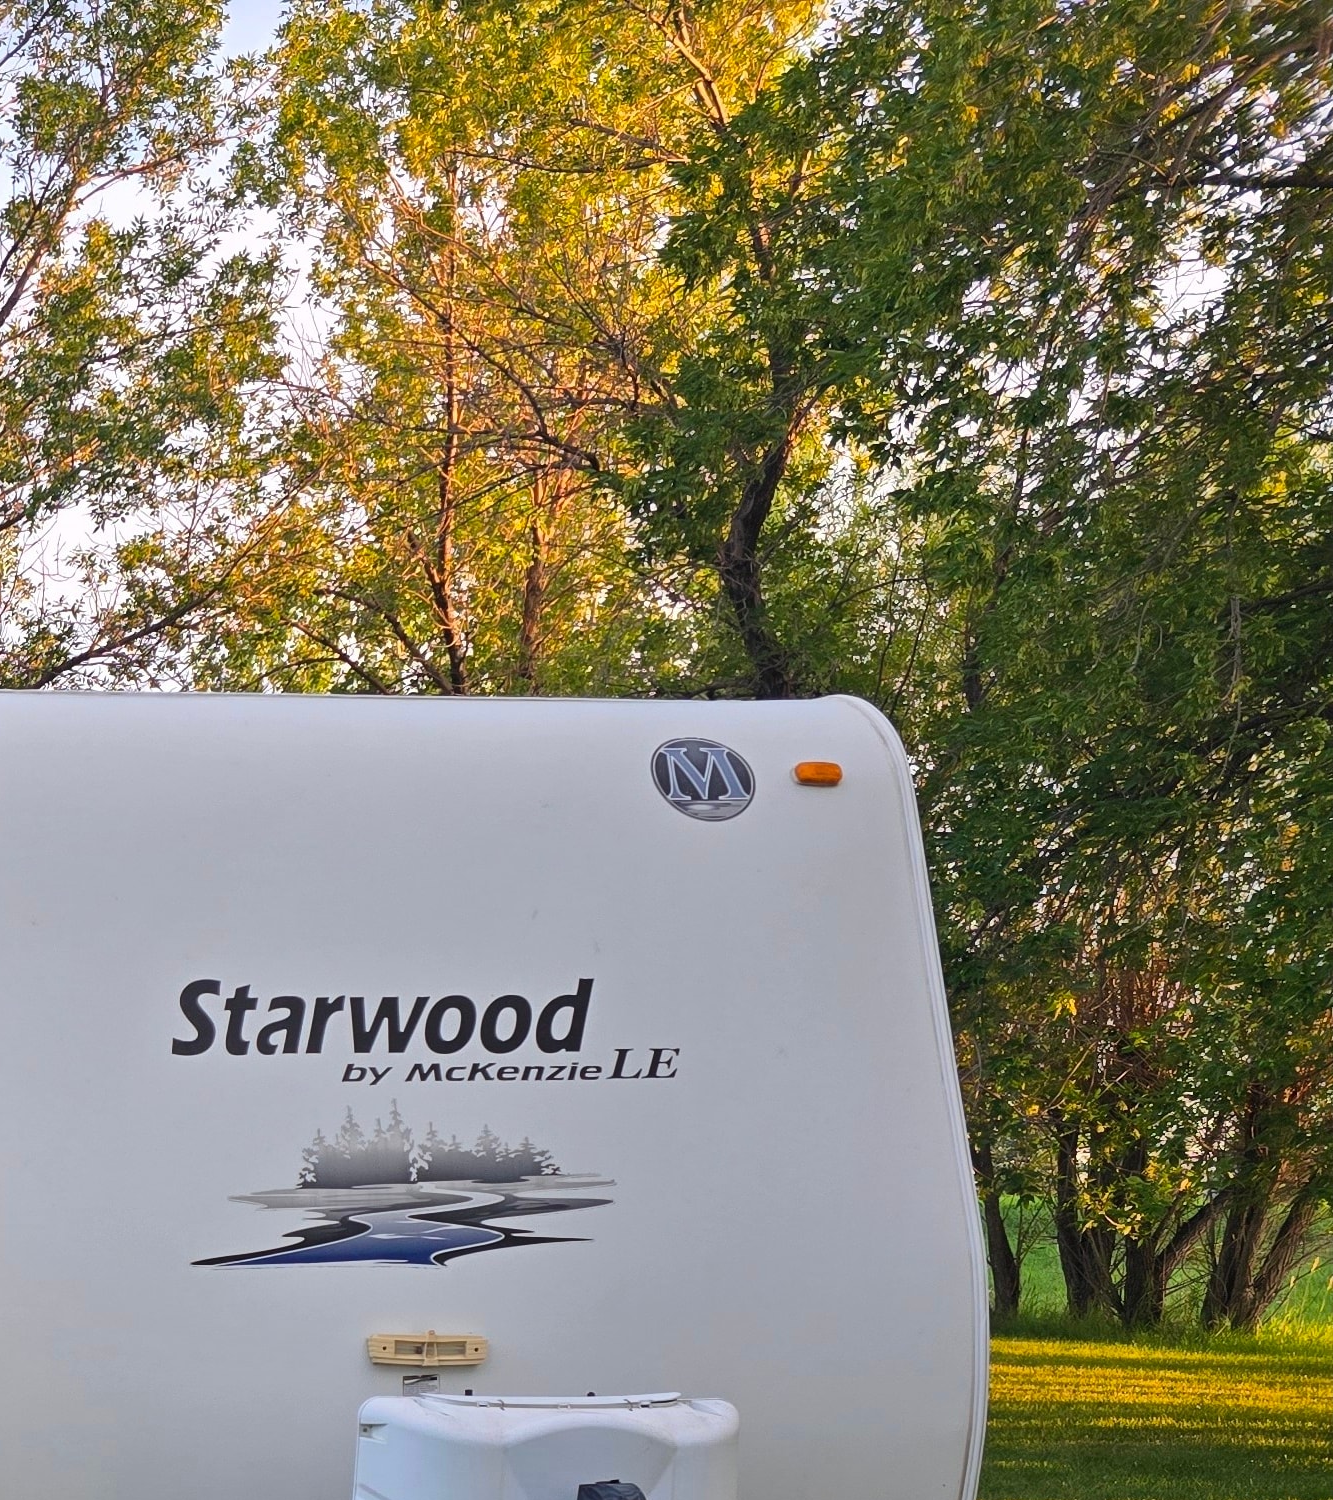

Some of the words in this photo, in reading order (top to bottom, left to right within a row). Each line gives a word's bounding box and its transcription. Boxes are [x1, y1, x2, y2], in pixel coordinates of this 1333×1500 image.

[660, 747, 750, 800] M
[171, 978, 595, 1056] Starwood
[341, 1062, 393, 1086] by
[405, 1062, 603, 1082] McKenzie
[607, 1047, 681, 1080] LE
